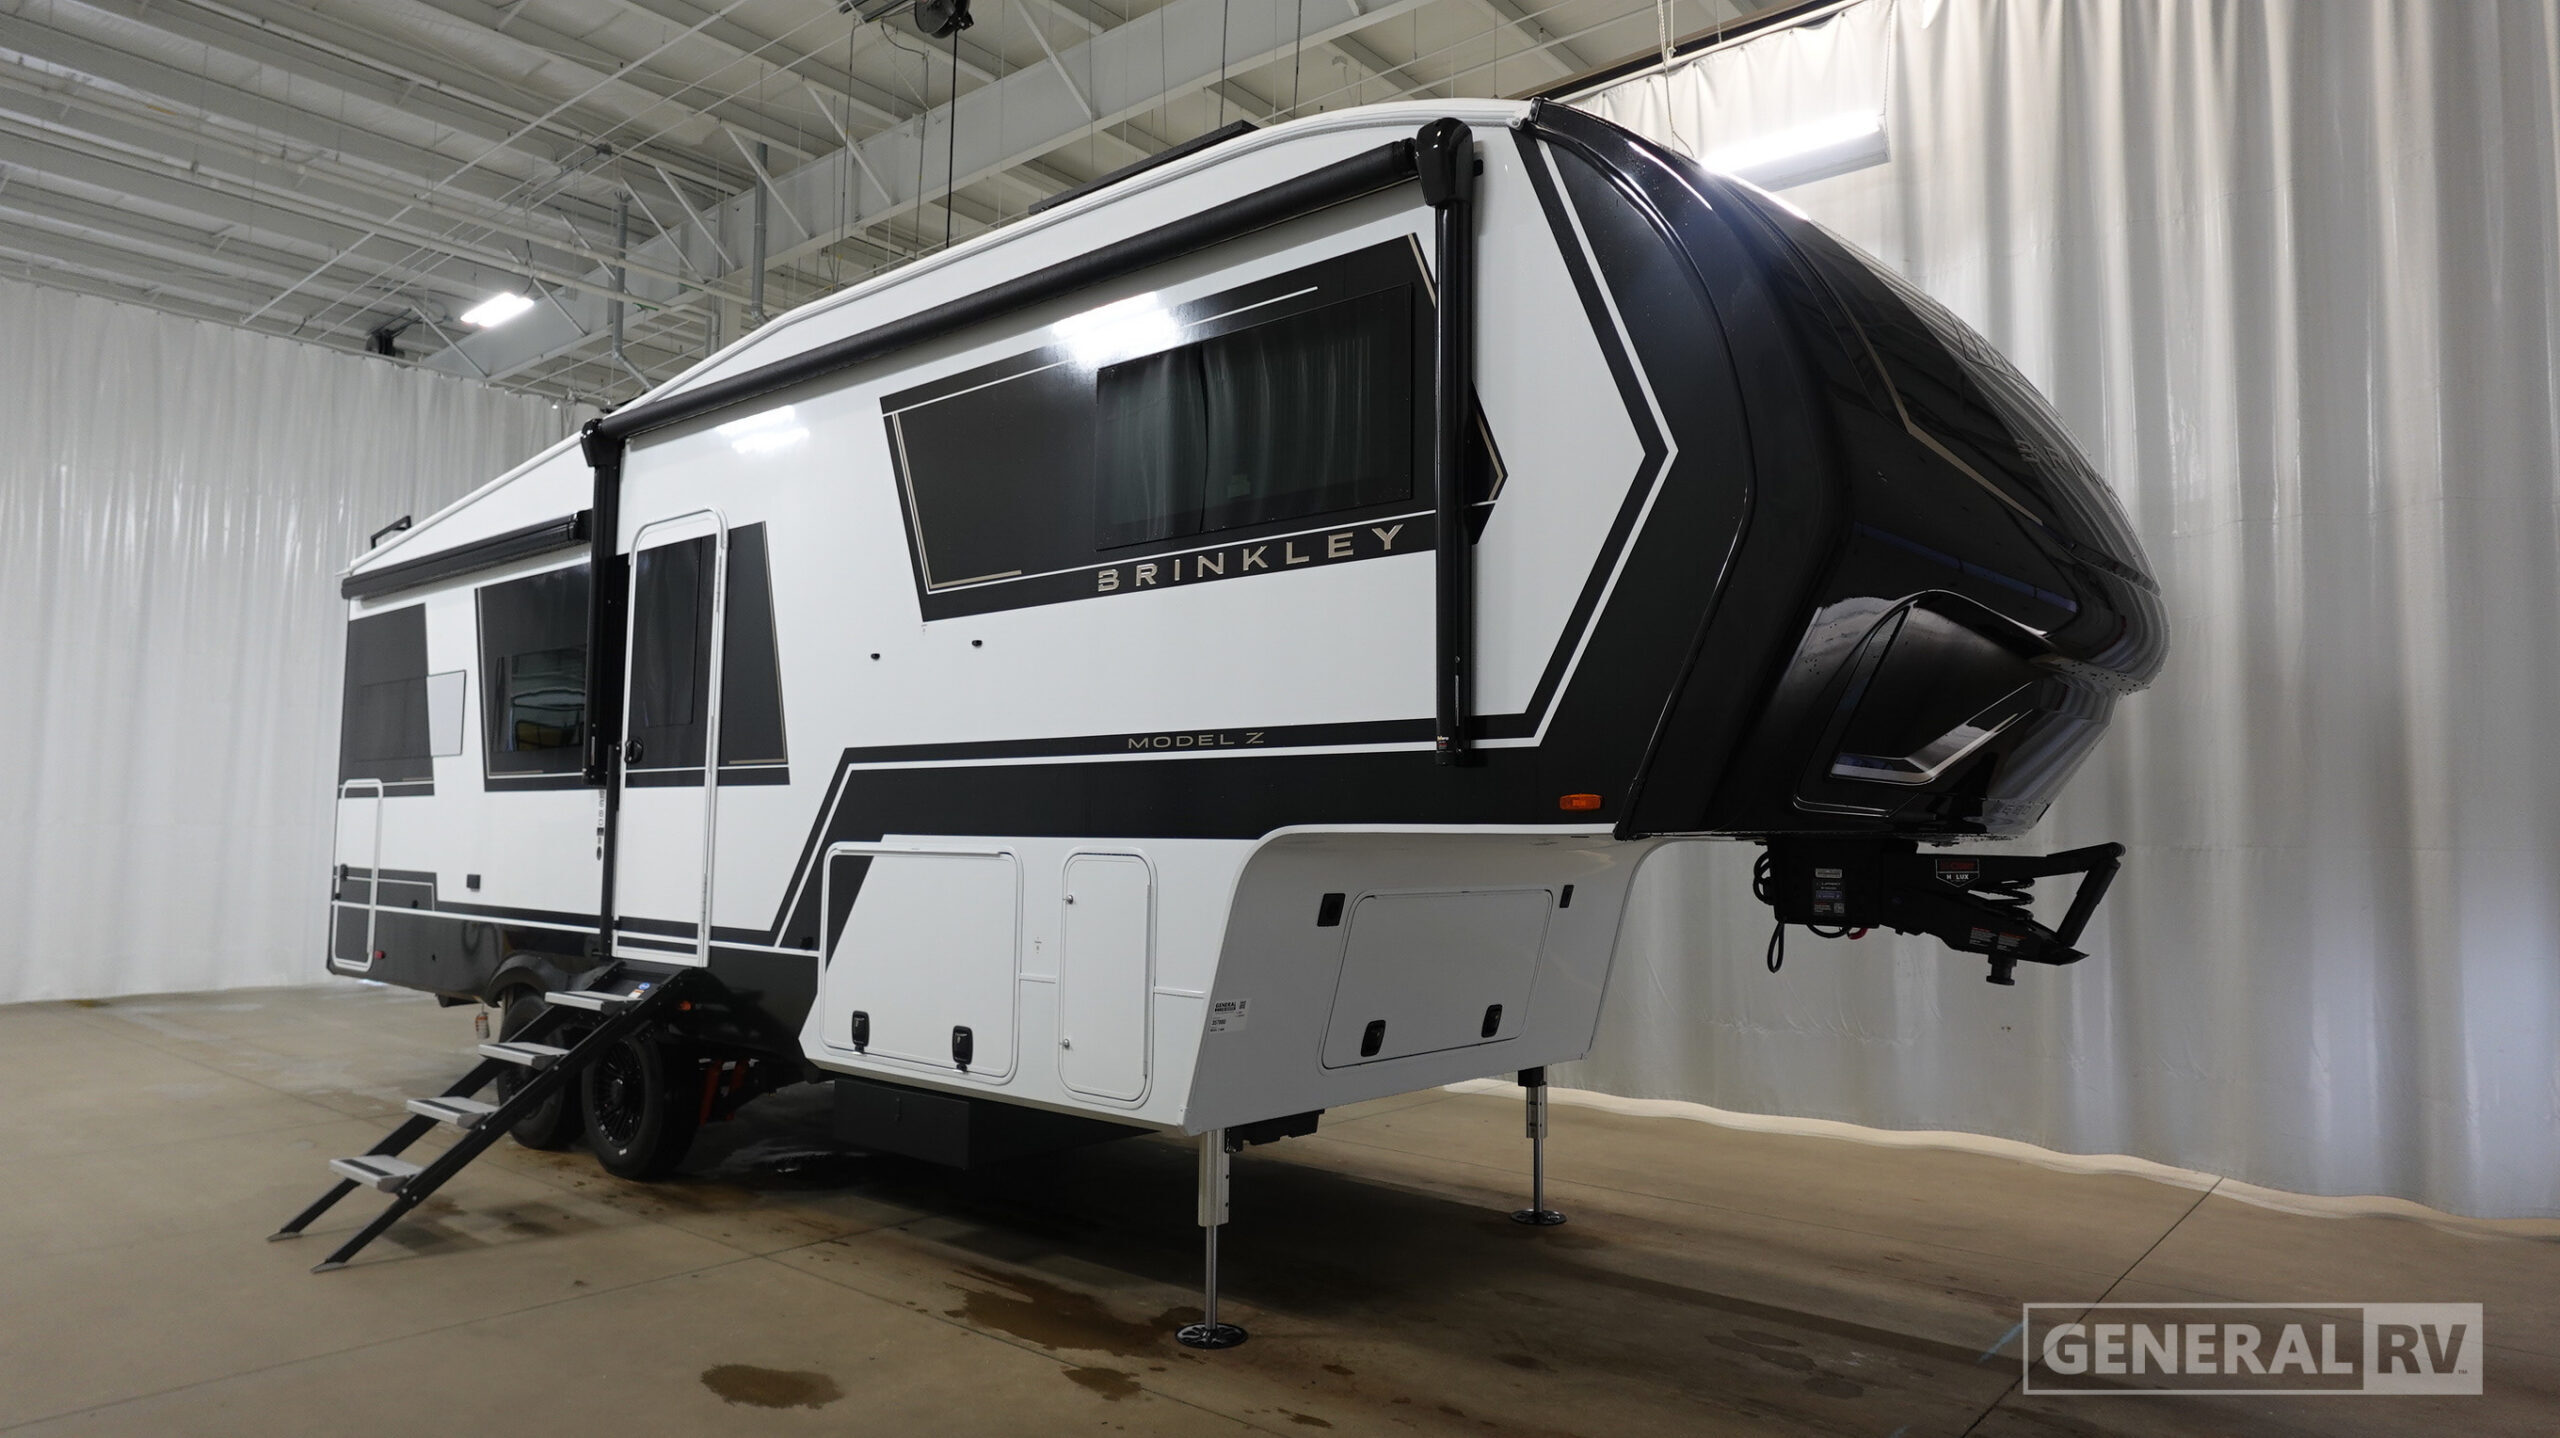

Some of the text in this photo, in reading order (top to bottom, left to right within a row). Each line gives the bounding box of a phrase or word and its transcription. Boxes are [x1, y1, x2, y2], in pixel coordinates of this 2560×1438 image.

[1097, 524, 1404, 592] BRINKLEY
[1128, 732, 1264, 749] MODEL Z
